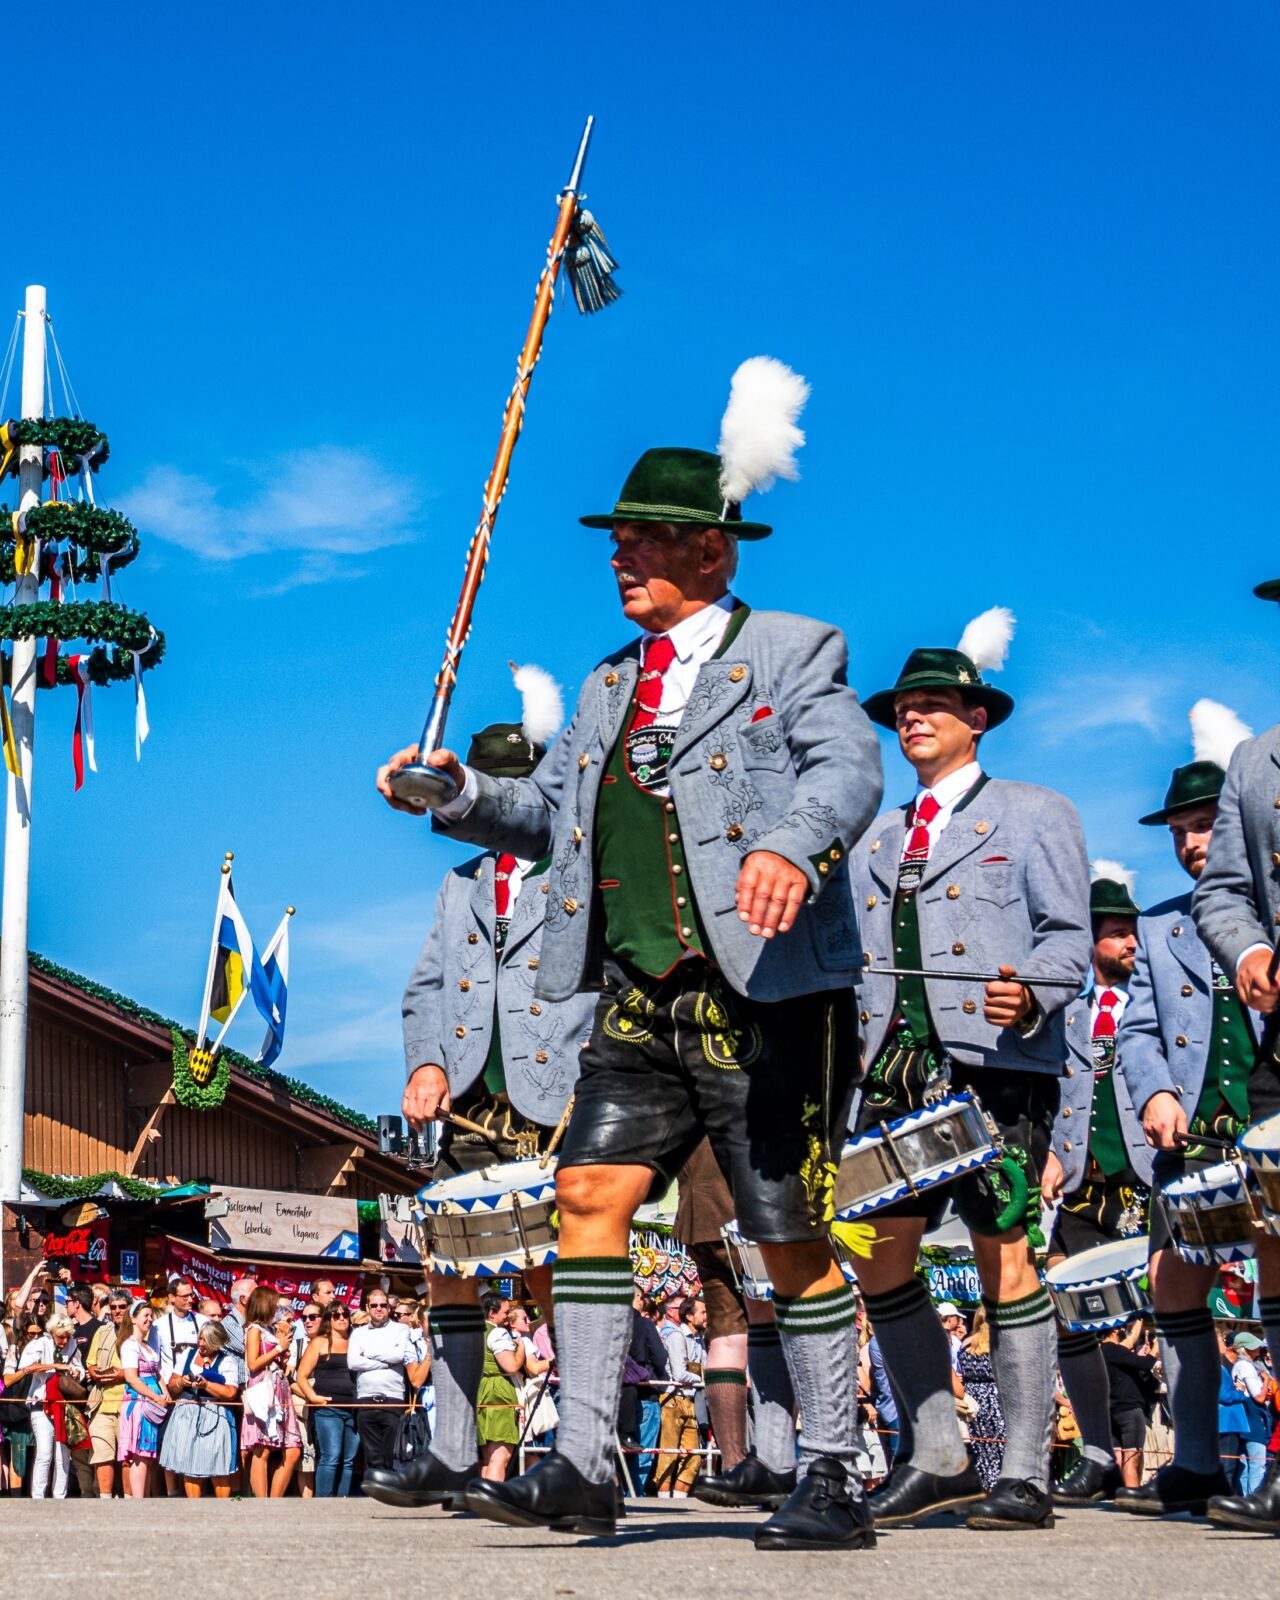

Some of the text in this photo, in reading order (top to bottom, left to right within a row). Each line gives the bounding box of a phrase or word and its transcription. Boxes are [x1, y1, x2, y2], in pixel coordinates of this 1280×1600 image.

[276, 1202, 312, 1219] Emmentaler
[292, 1224, 320, 1243] Veganes
[125, 1255, 135, 1266] 37
